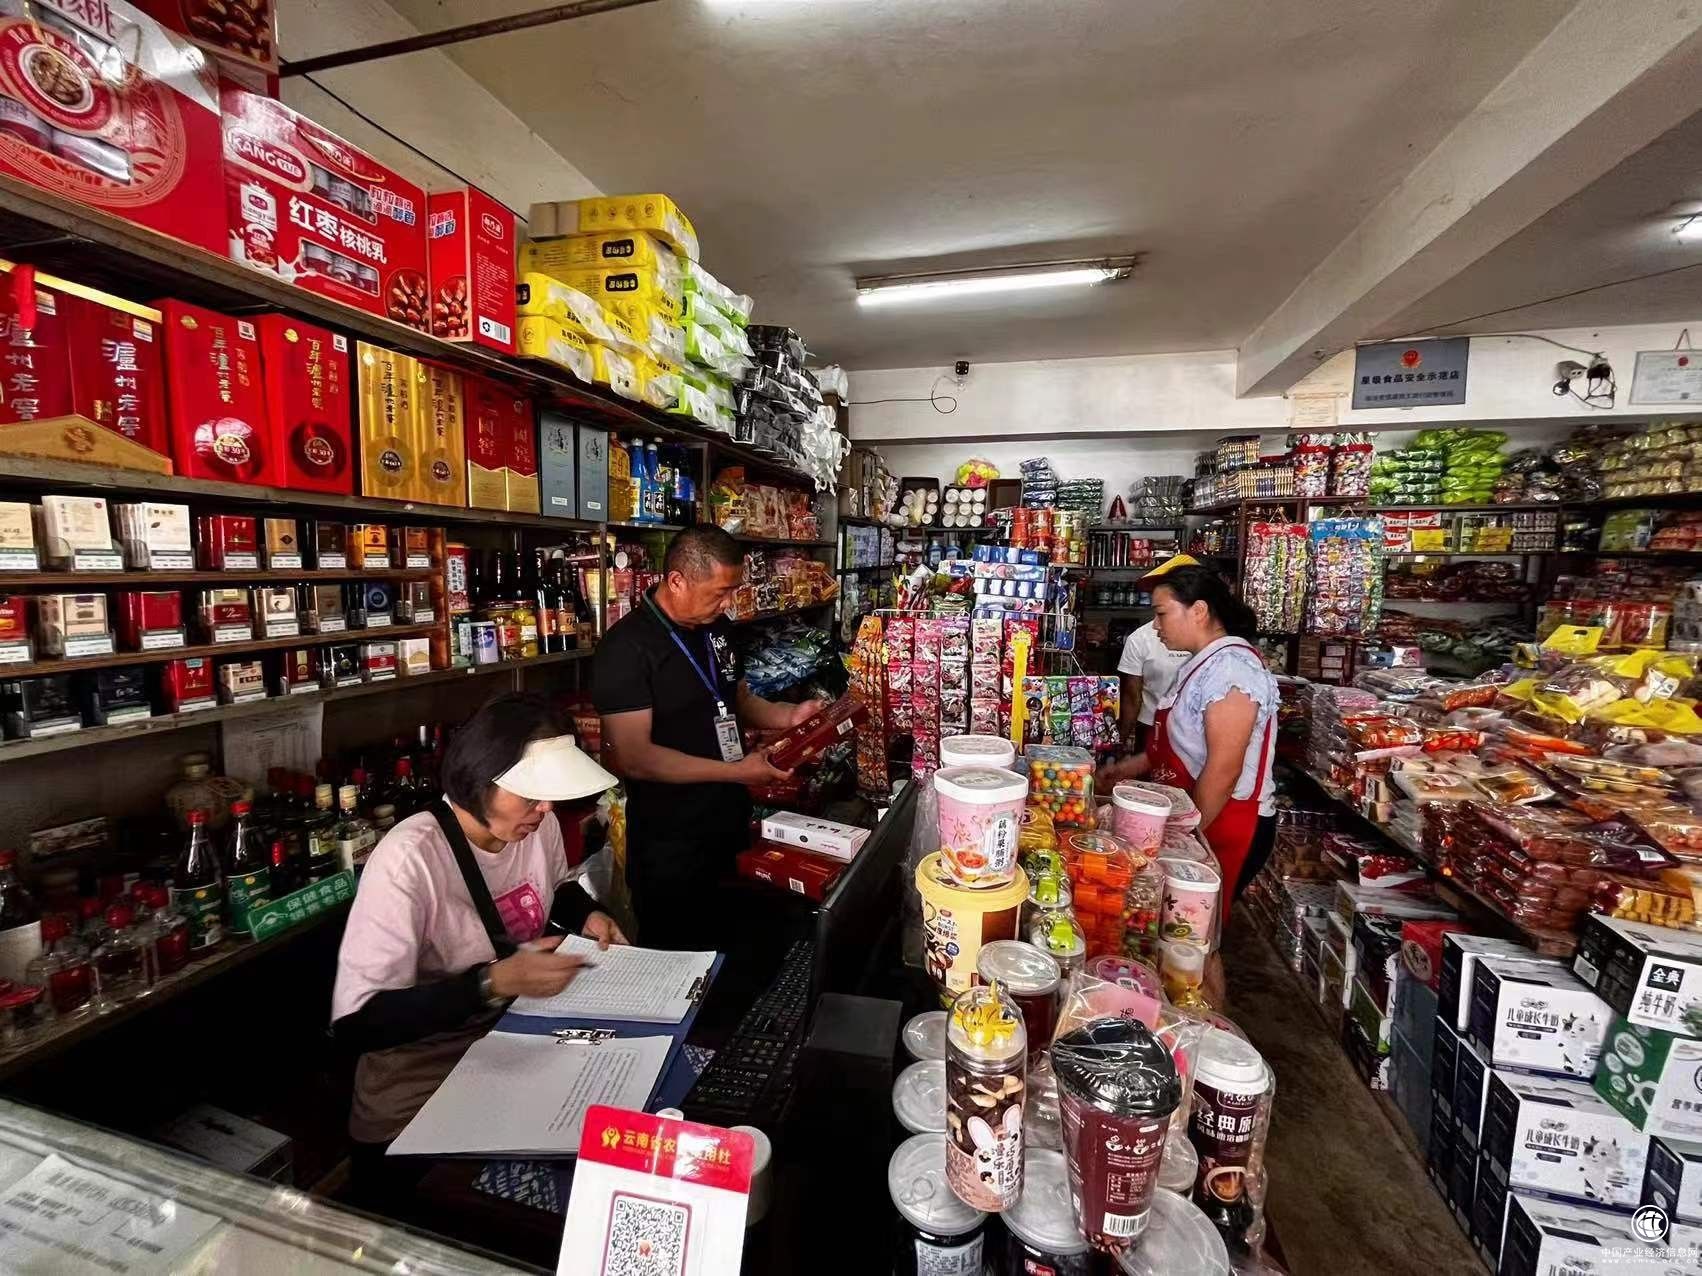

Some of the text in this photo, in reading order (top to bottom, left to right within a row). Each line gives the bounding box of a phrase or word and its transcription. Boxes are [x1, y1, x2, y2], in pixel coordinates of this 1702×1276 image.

[288, 195, 388, 265] 红枣核桃乳
[1360, 369, 1460, 385] 星级食品安全示范店
[1506, 1007, 1560, 1028] 儿童成长牛奶
[1525, 1127, 1581, 1151] 儿童成长牛奶
